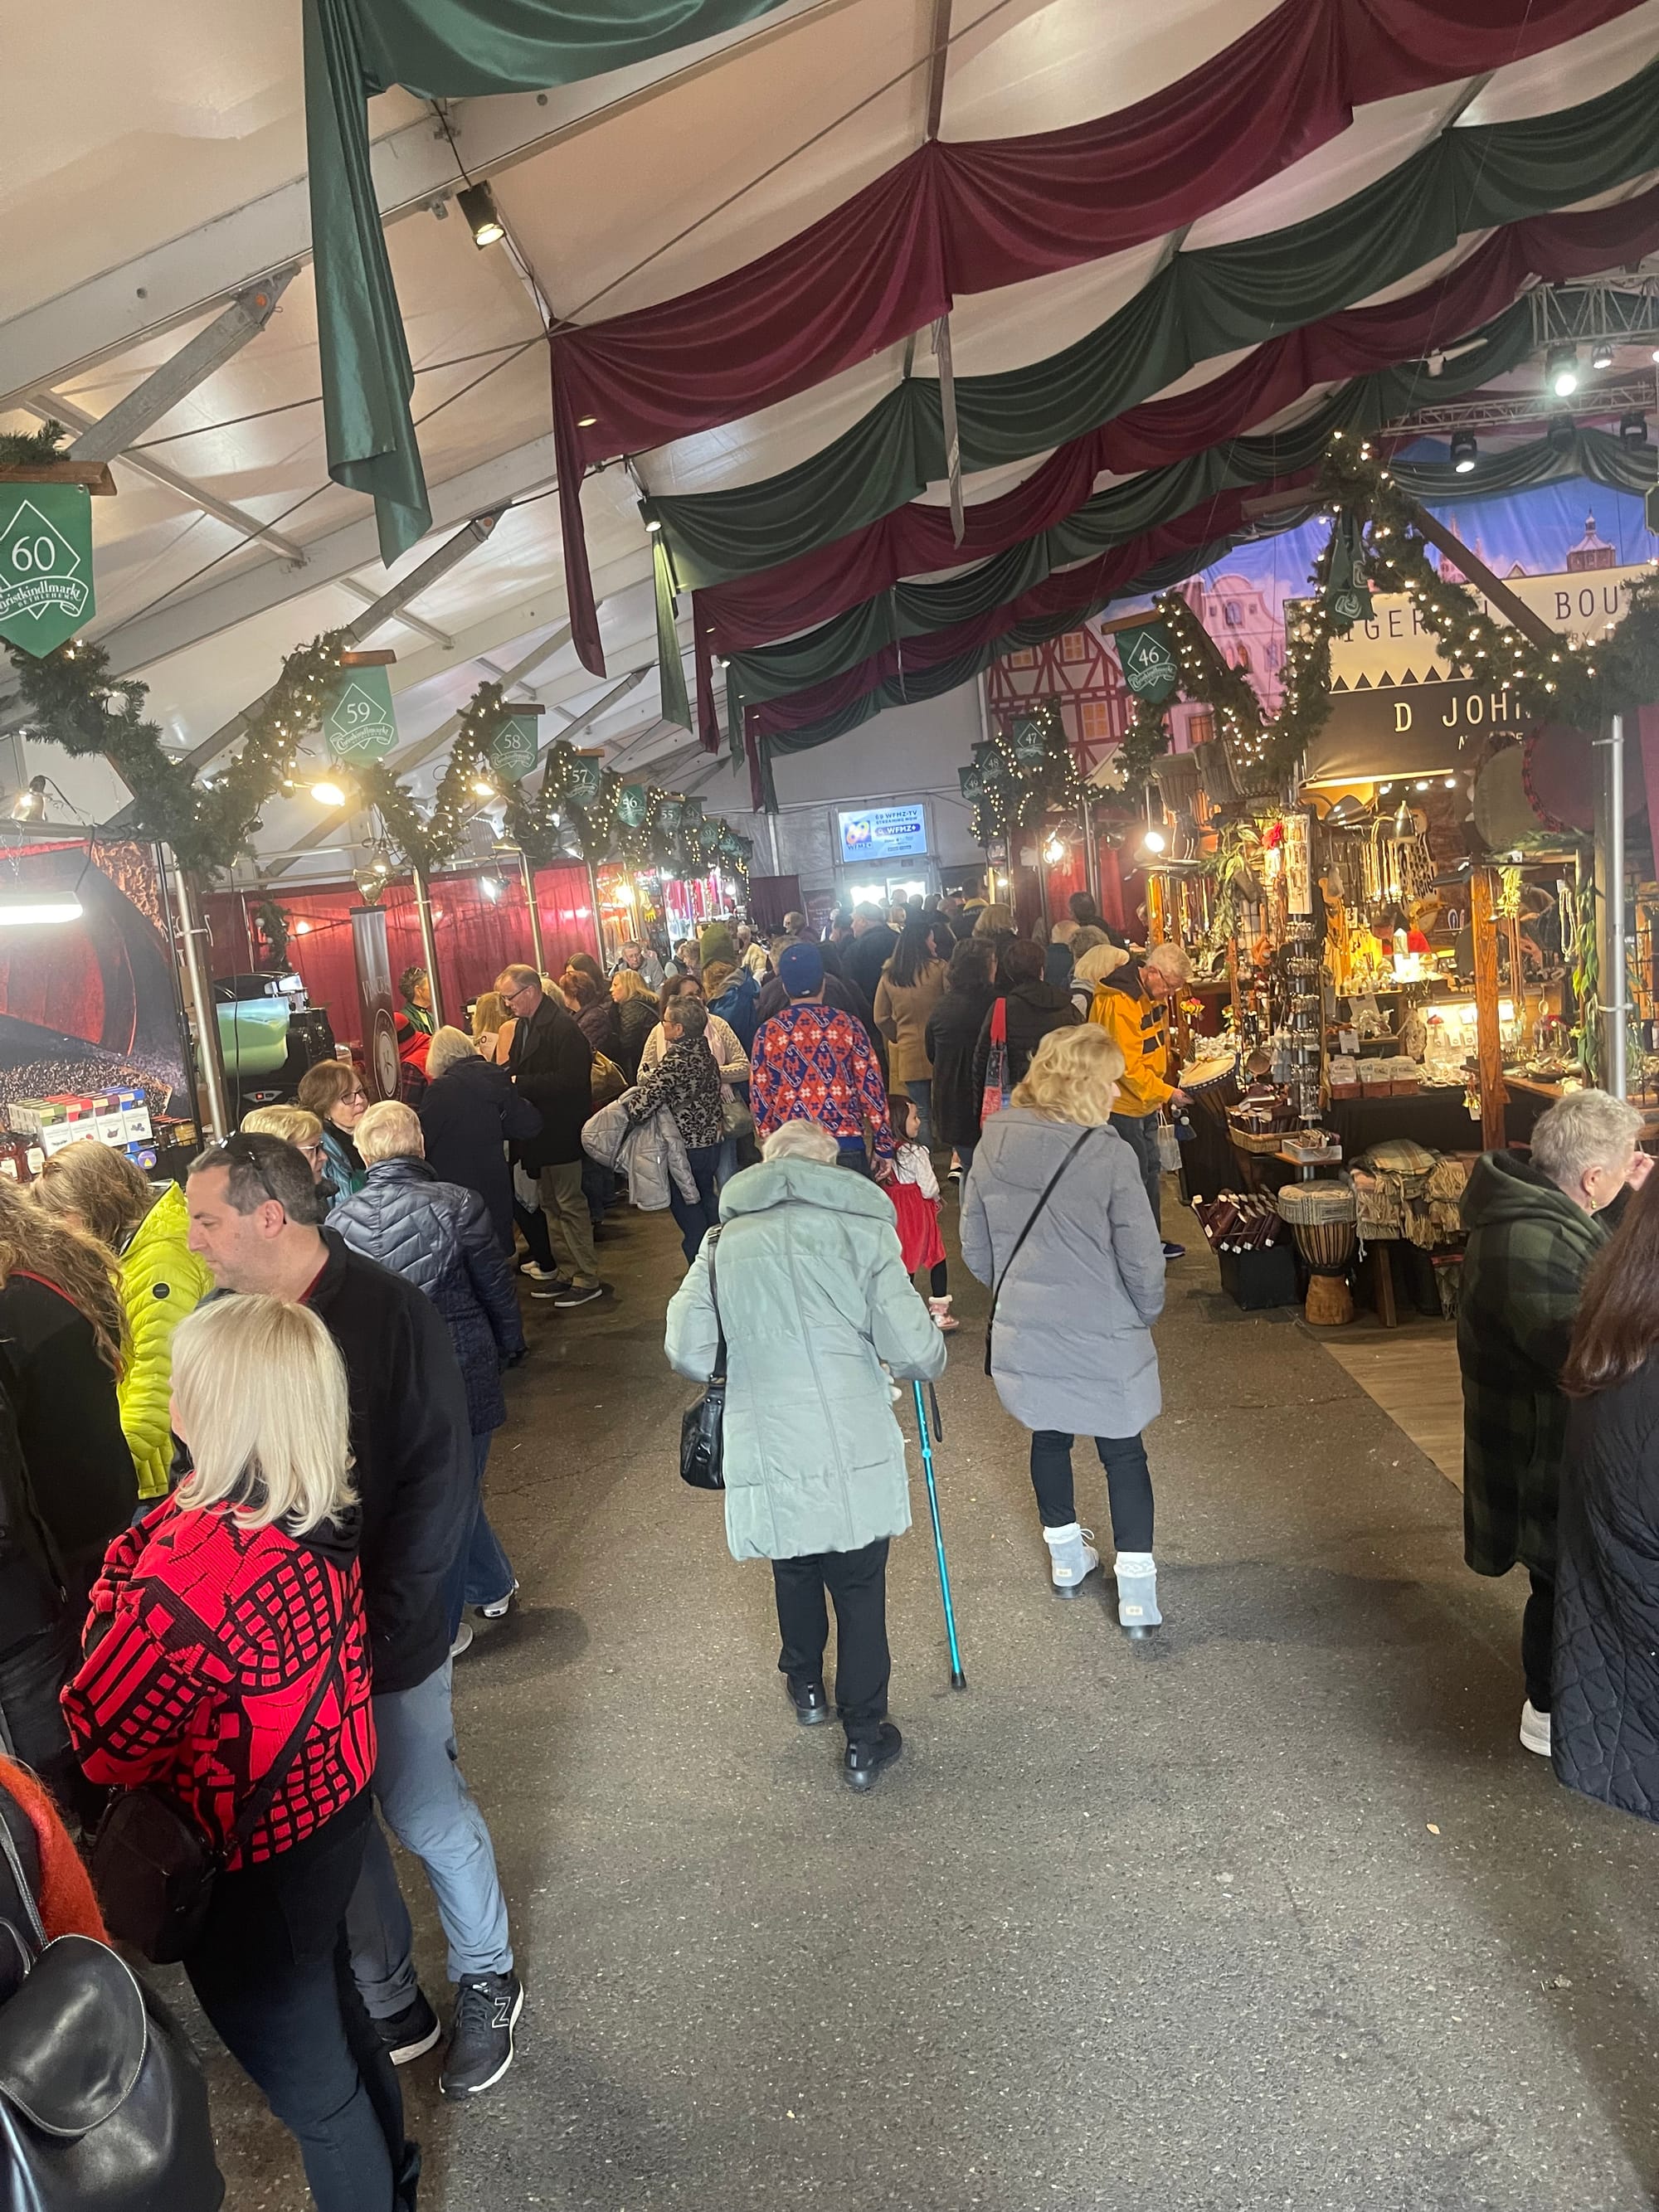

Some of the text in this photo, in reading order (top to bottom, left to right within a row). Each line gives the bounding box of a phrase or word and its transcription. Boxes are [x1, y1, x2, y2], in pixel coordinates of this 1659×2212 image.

[12, 536, 56, 571] 60
[0, 580, 81, 615] hristkindlmarkt
[1138, 645, 1160, 667] 46
[347, 702, 371, 724] 59
[1394, 702, 1413, 732] D
[504, 734, 521, 749] 58
[1025, 732, 1037, 744] 47
[572, 770, 588, 784] 57
[622, 797, 638, 809] 56
[661, 809, 674, 819] 55
